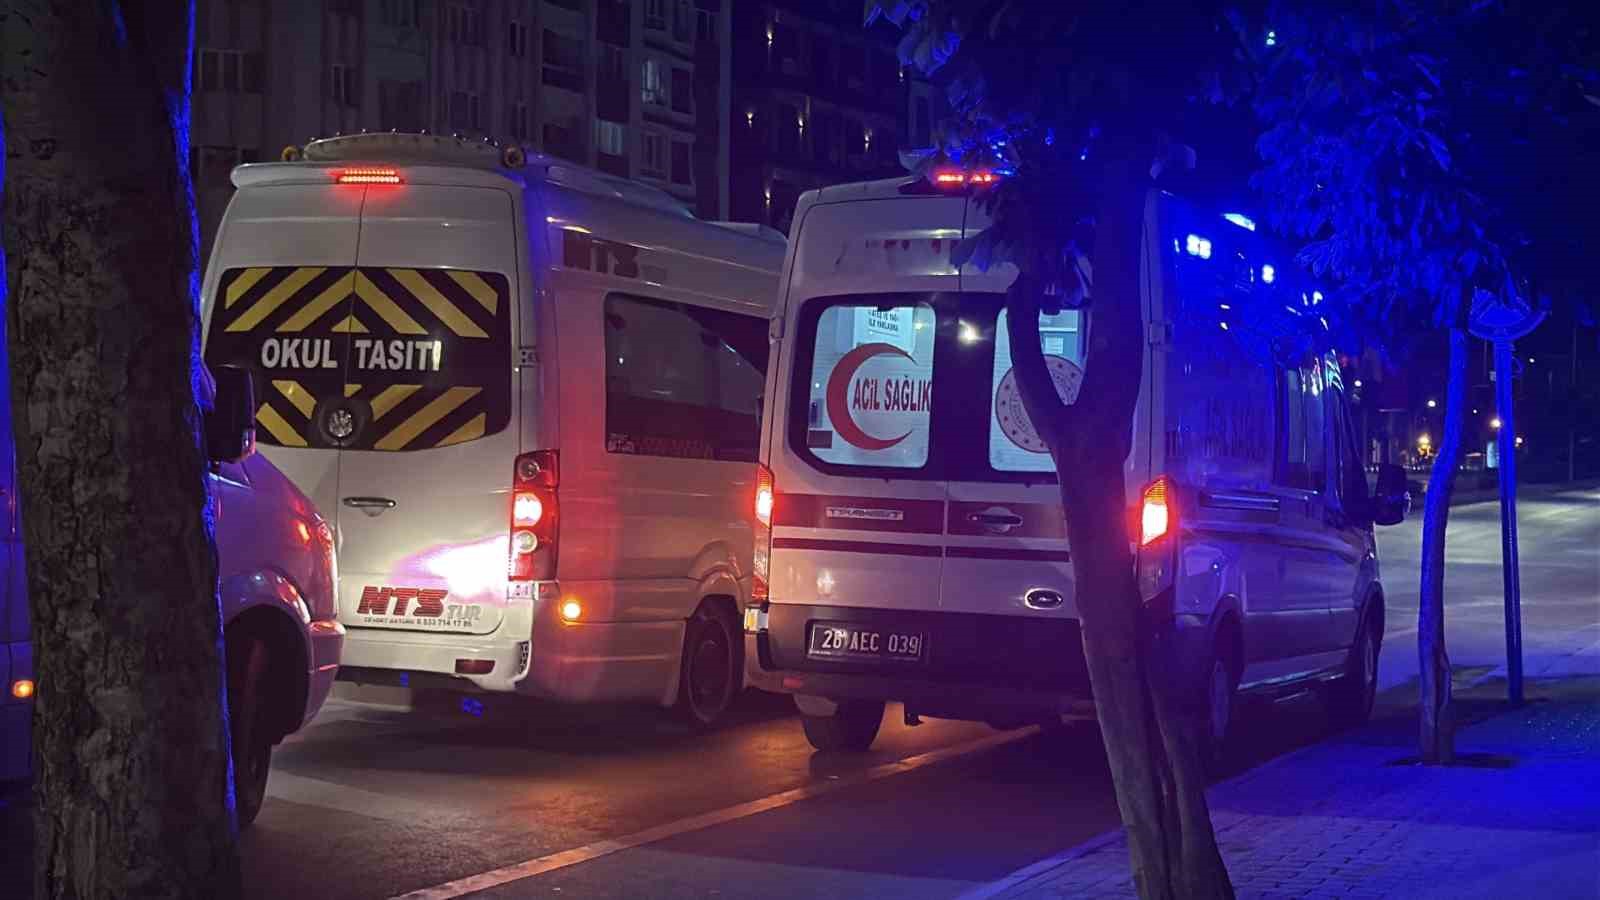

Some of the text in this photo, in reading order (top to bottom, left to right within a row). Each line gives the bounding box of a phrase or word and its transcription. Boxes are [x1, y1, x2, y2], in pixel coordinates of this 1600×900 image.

[261, 338, 442, 371] OKUL TASITI
[884, 374, 931, 412] SAĞLIK
[356, 586, 481, 620] NTS TUR
[849, 631, 880, 652] AEC
[888, 633, 919, 654] 039
